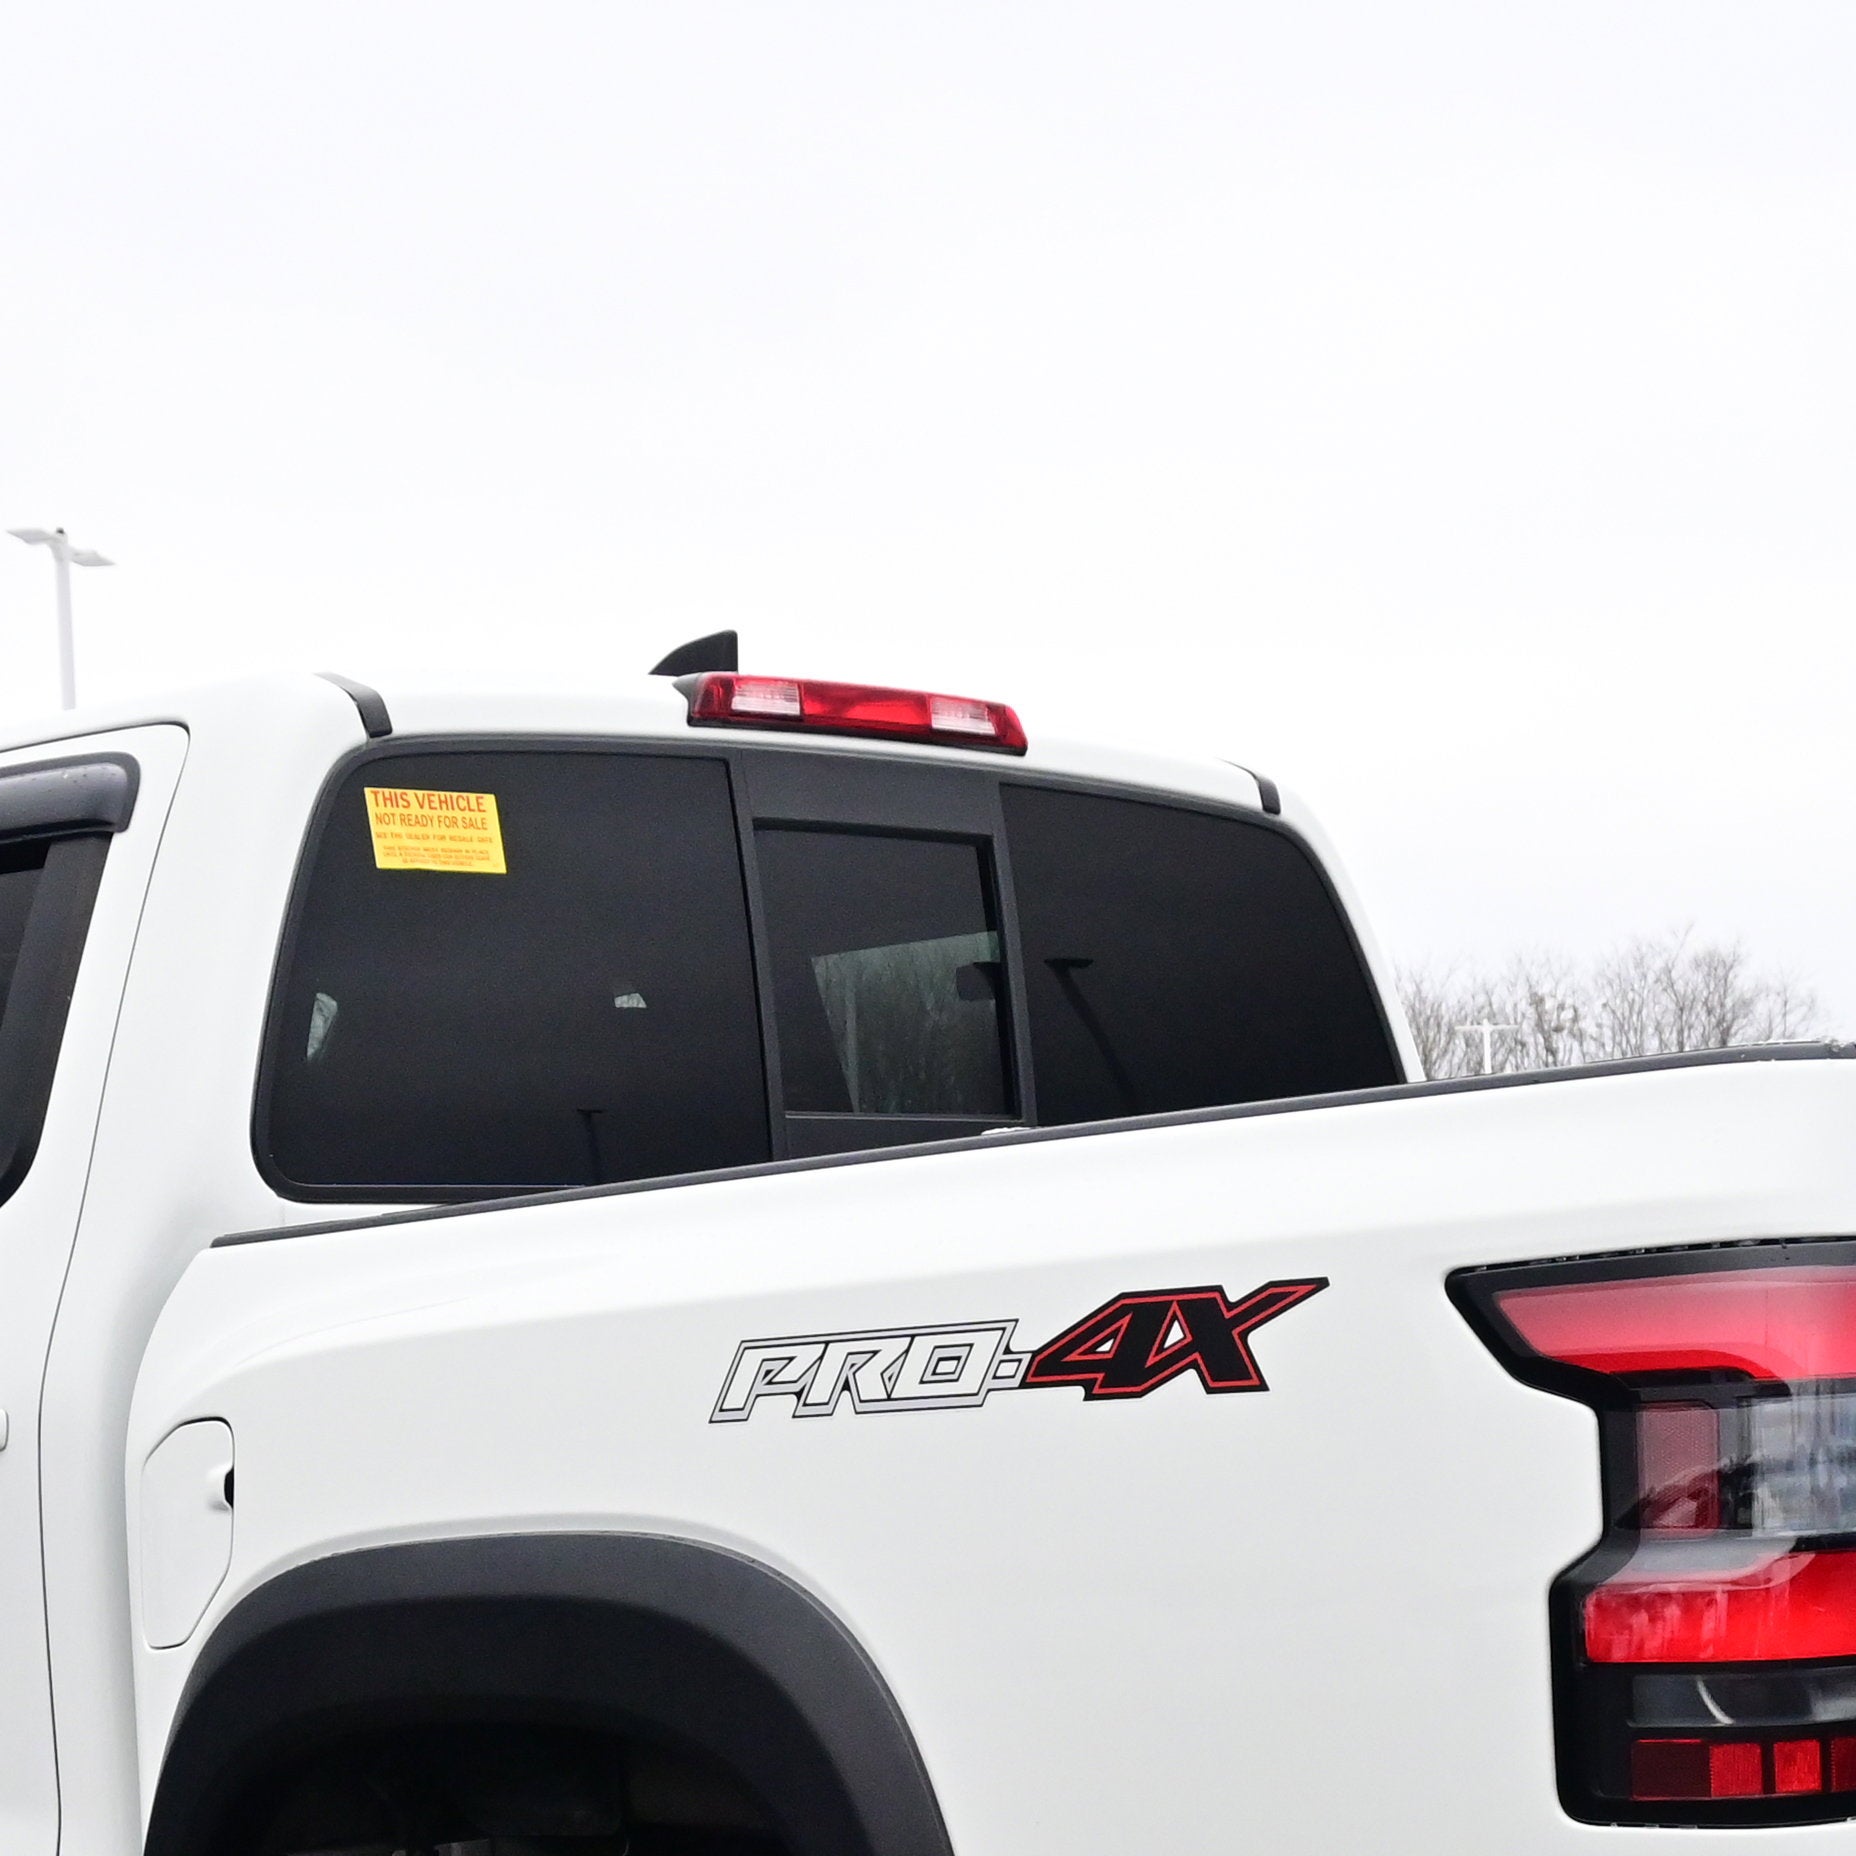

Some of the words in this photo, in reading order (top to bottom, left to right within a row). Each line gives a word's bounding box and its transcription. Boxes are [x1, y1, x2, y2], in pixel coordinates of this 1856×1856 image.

[370, 790, 411, 809] THIS
[414, 792, 487, 813] VEHICLE
[374, 812, 397, 826] NOT
[399, 813, 434, 828] READY
[437, 815, 459, 829] FOR
[461, 816, 488, 830] SALE
